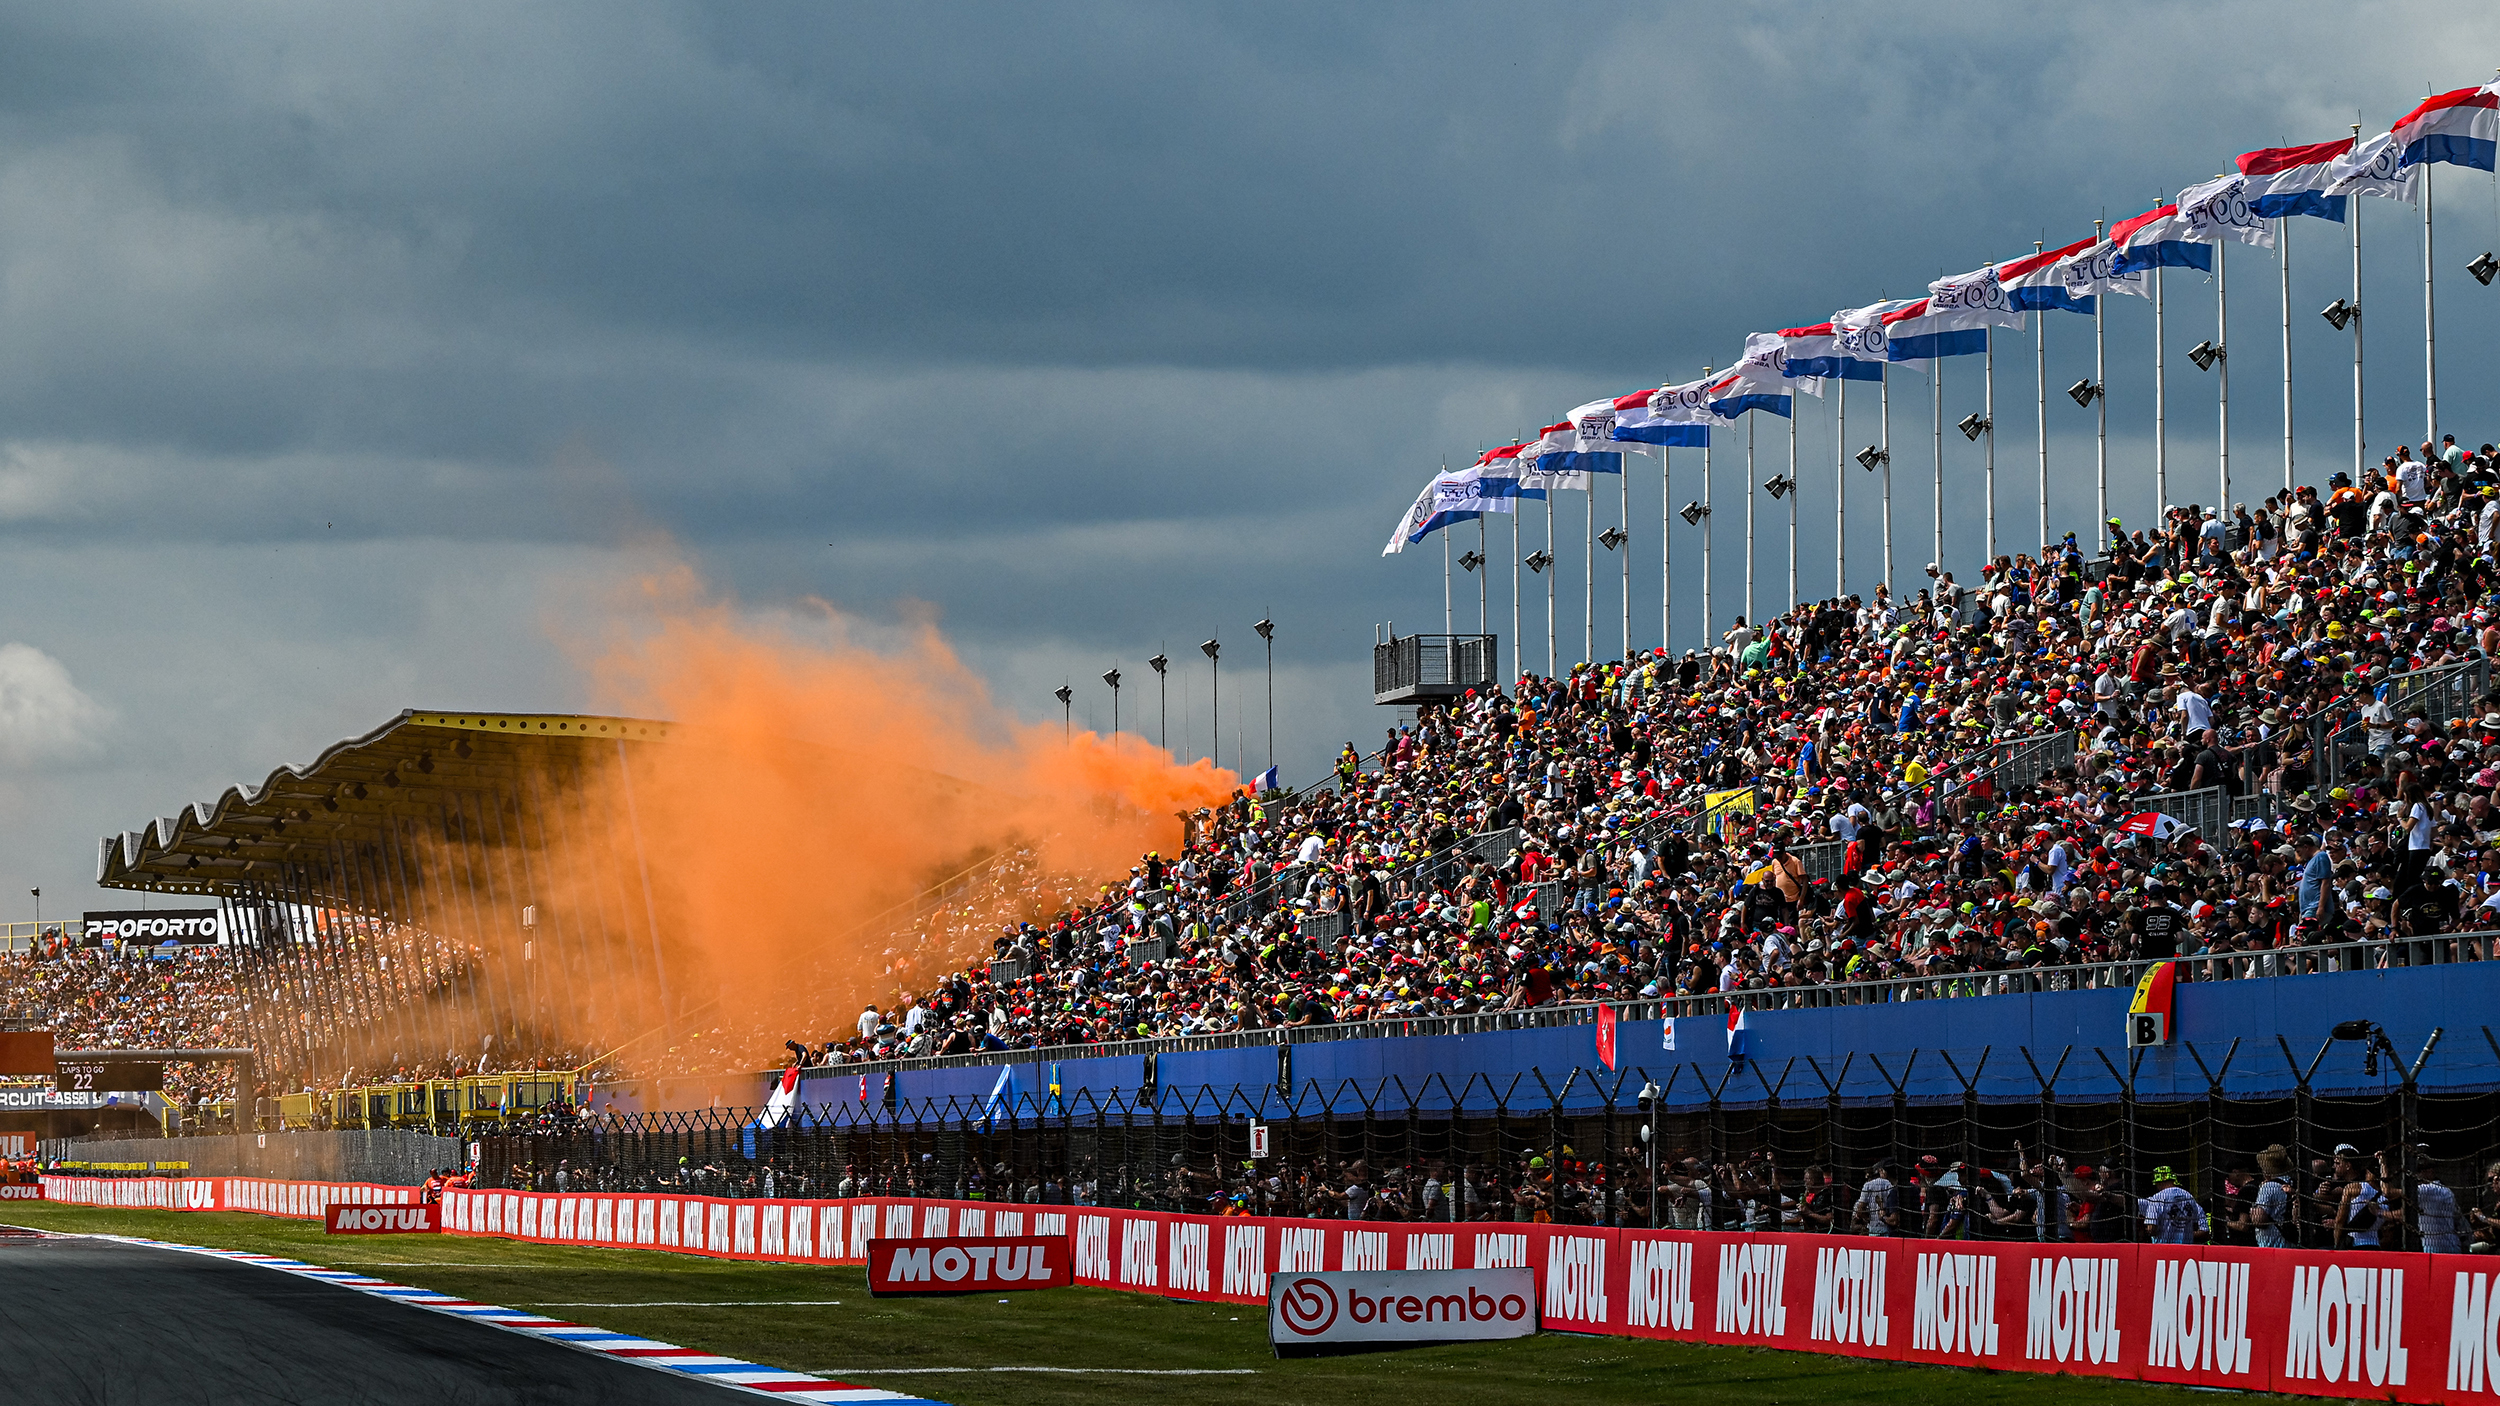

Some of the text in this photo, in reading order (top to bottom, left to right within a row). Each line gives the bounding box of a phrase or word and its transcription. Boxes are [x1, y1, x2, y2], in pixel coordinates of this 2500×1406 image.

[85, 917, 218, 938] PROFORTO
[1123, 998, 1135, 1012] 21
[2136, 1016, 2157, 1045] B
[55, 1091, 89, 1105] ASSEN
[61, 1066, 105, 1074] LAPS TO GO
[74, 1073, 93, 1090] 22
[337, 1209, 430, 1230] MOTUL
[1075, 1214, 1110, 1281] MOTUL
[1120, 1218, 1158, 1287] MOTUL
[888, 1246, 1052, 1282] MOTUL
[1169, 1222, 1210, 1293] MOTUL
[1222, 1224, 1267, 1297] MOTUL
[1545, 1234, 1608, 1324] MOTUL
[1627, 1239, 1694, 1331] MOTUL
[1715, 1242, 1788, 1338] MOTUL
[1349, 1286, 1527, 1324] brembo
[1810, 1246, 1889, 1347] MOTUL
[1912, 1252, 1999, 1357] MOTUL
[2025, 1256, 2121, 1365] MOTUL
[2147, 1258, 2252, 1375] MOTUL
[2285, 1264, 2408, 1387] MOTUL
